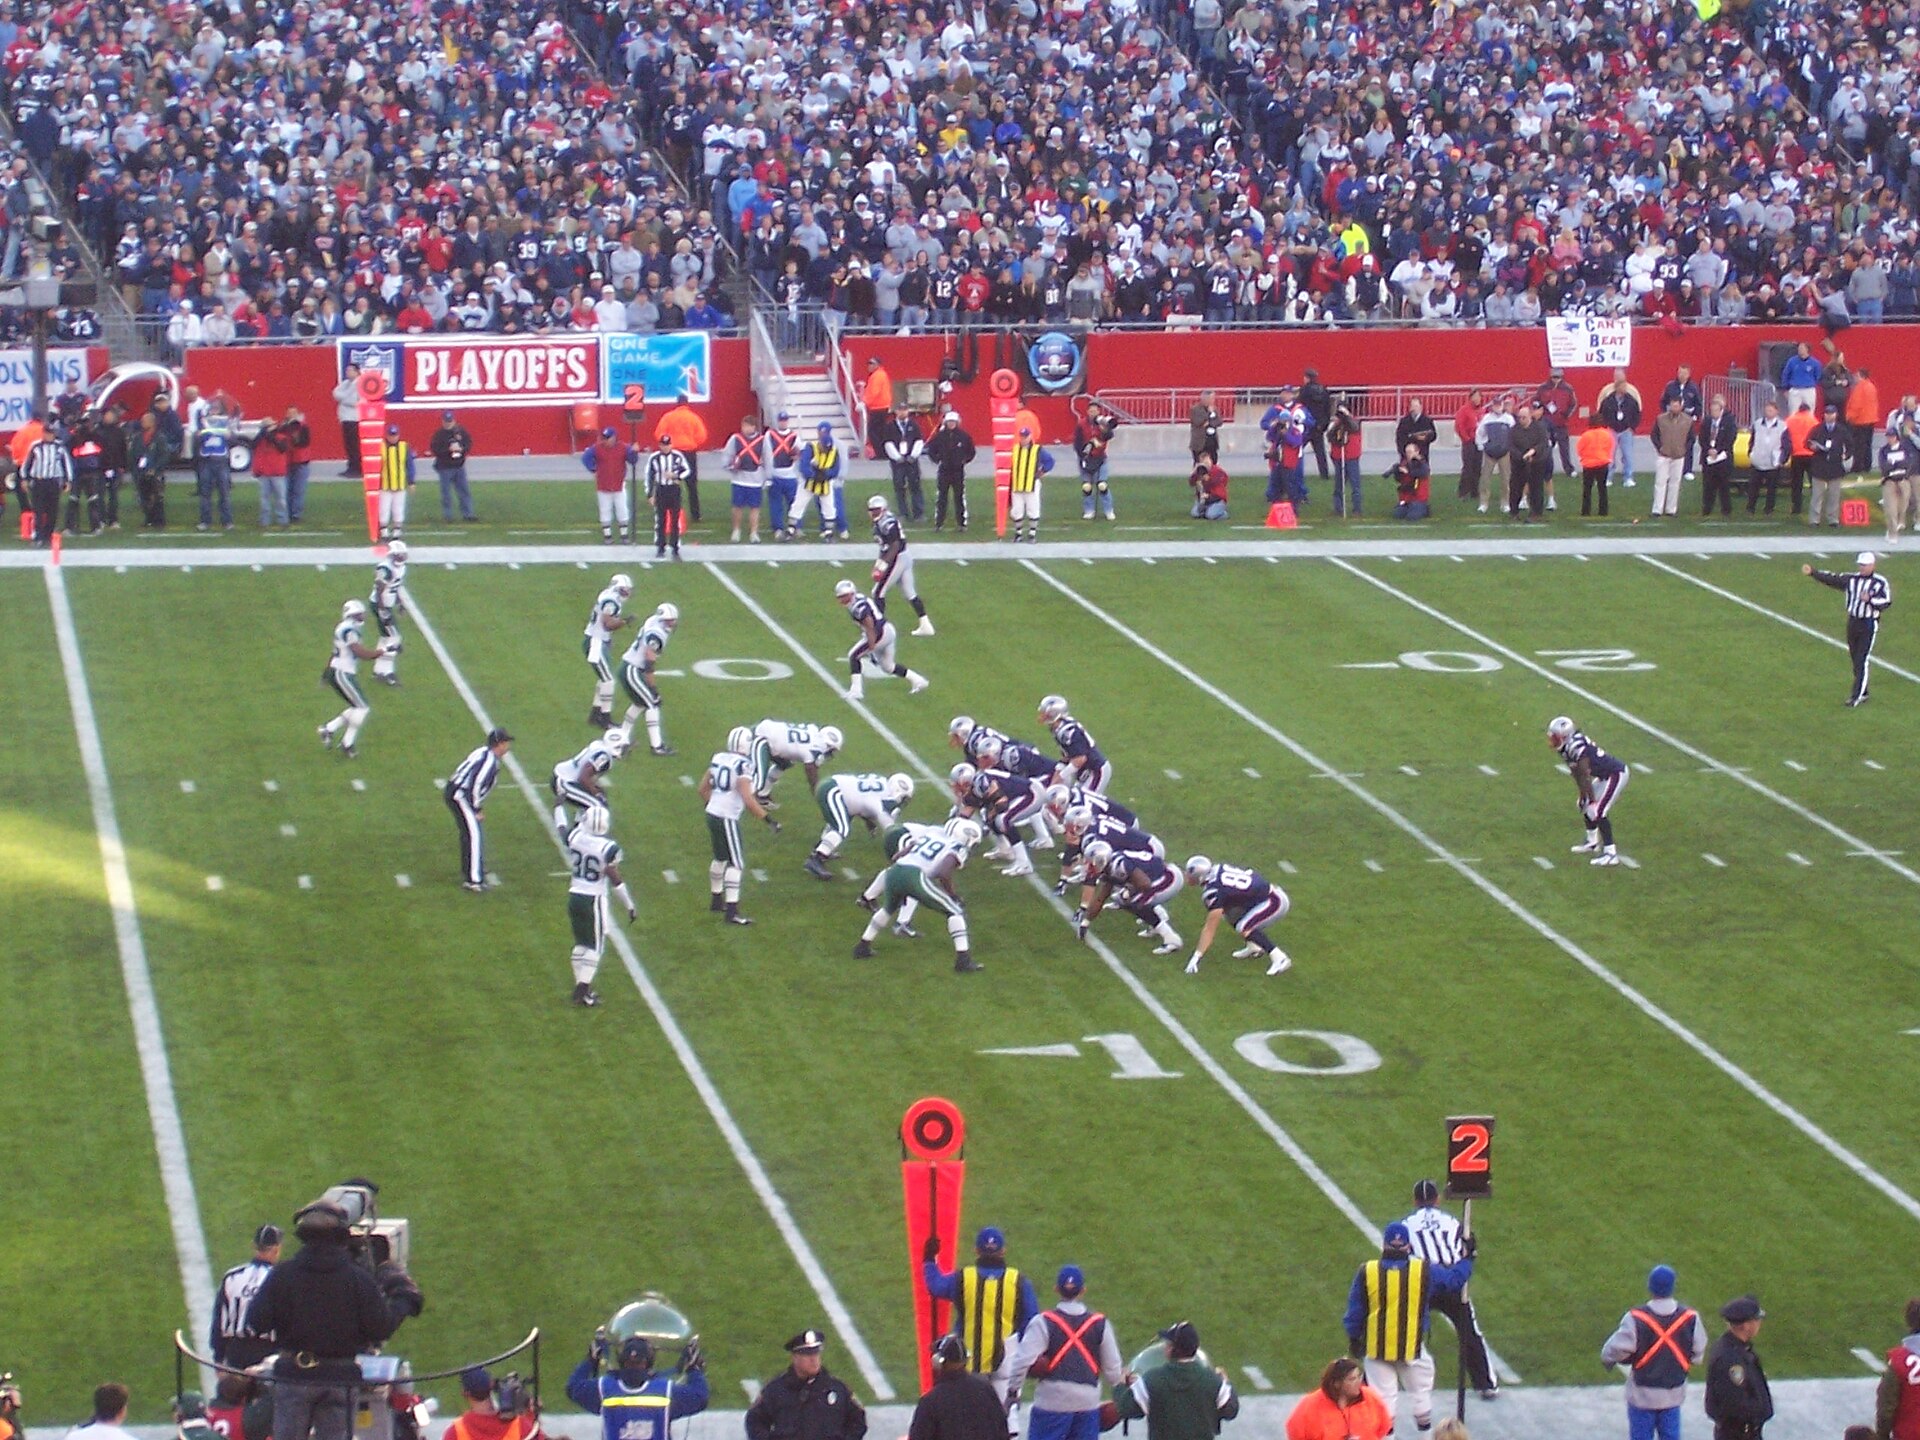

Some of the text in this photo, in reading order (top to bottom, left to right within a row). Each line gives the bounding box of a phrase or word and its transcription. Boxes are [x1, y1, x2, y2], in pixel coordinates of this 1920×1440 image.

[517, 242, 538, 259] 39
[1659, 264, 1679, 279] 93
[936, 280, 952, 298] 12
[610, 338, 648, 350] ONE
[611, 351, 661, 364] GAME
[414, 347, 588, 392] PLAYOFFS
[612, 368, 647, 380] ONE
[625, 386, 644, 410] 2
[570, 848, 600, 883] 36
[1450, 1123, 1490, 1173] 2
